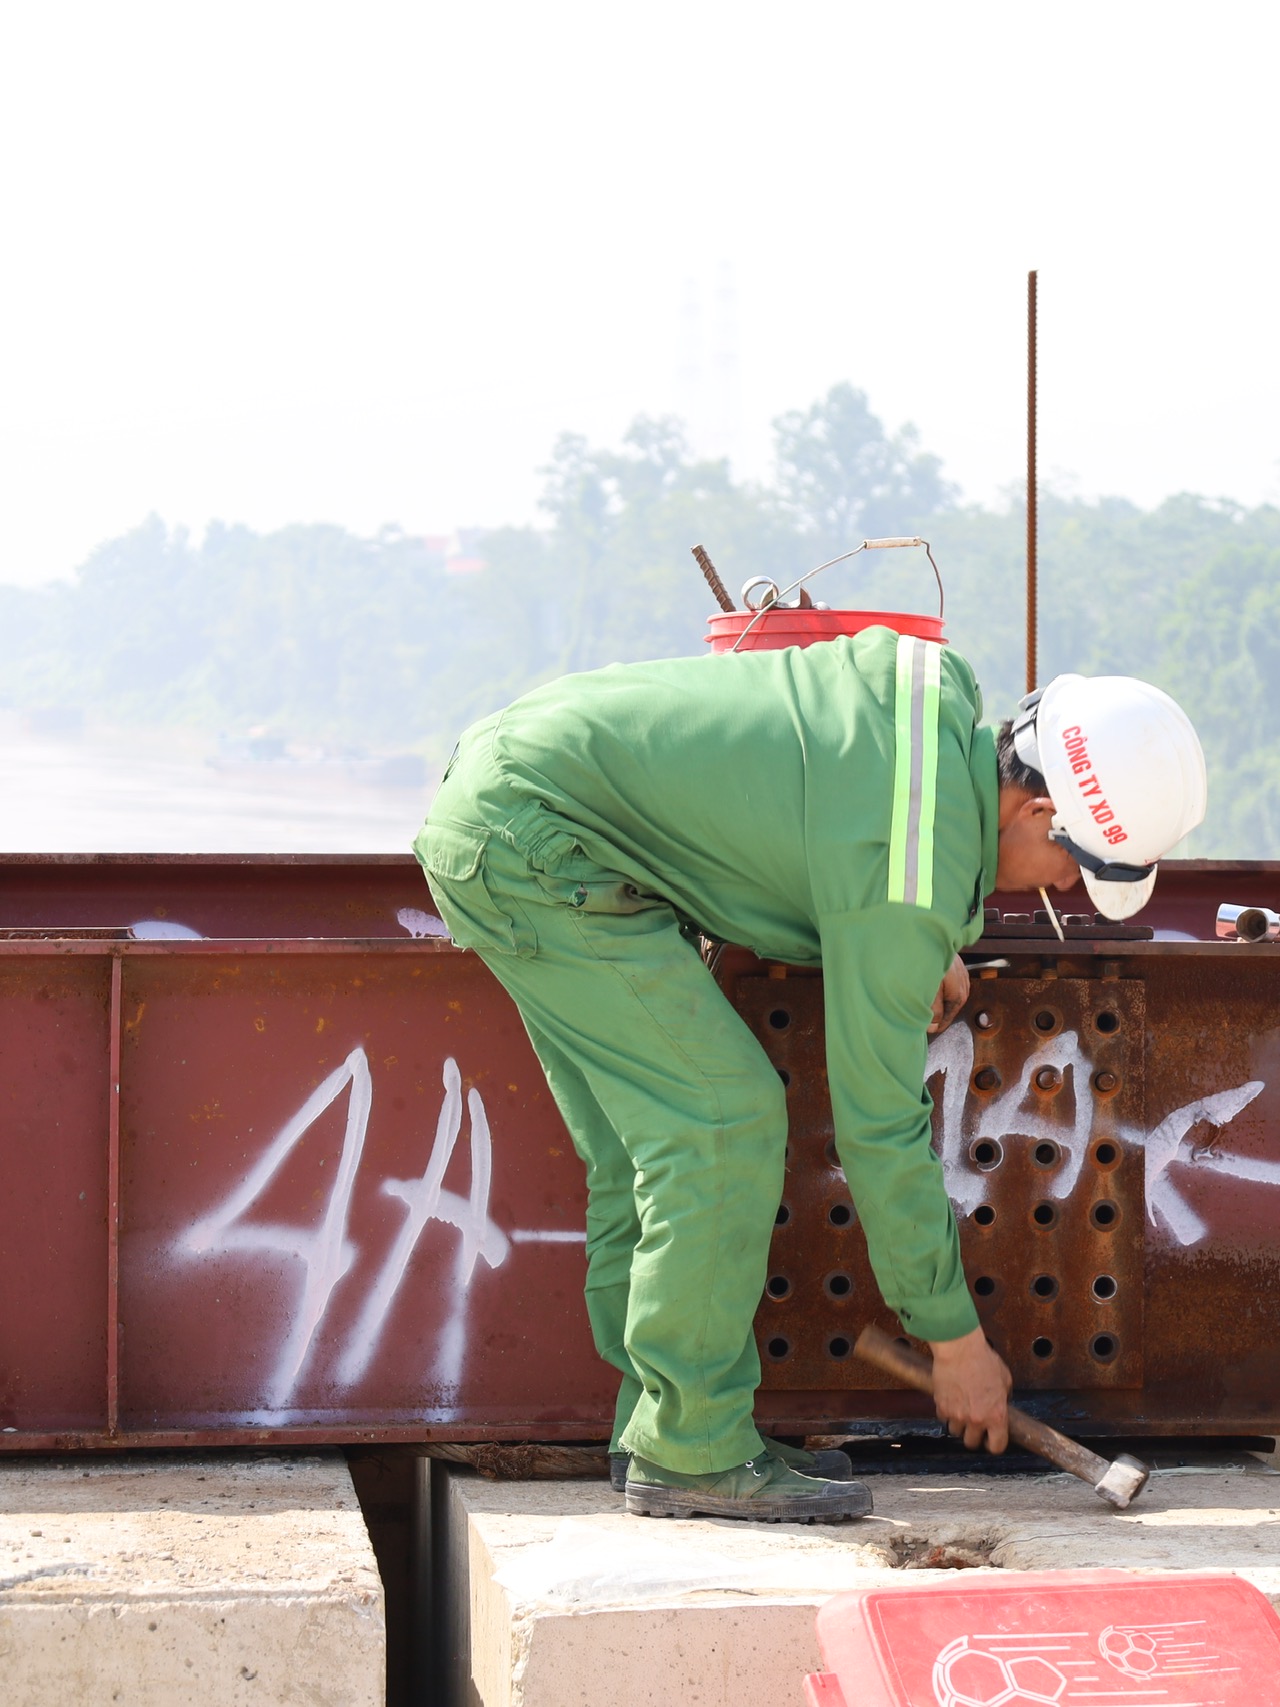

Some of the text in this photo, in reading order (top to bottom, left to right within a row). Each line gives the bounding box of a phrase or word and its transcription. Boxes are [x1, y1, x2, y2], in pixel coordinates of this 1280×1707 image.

[1062, 725, 1128, 845] CÔNG TY XD 99
